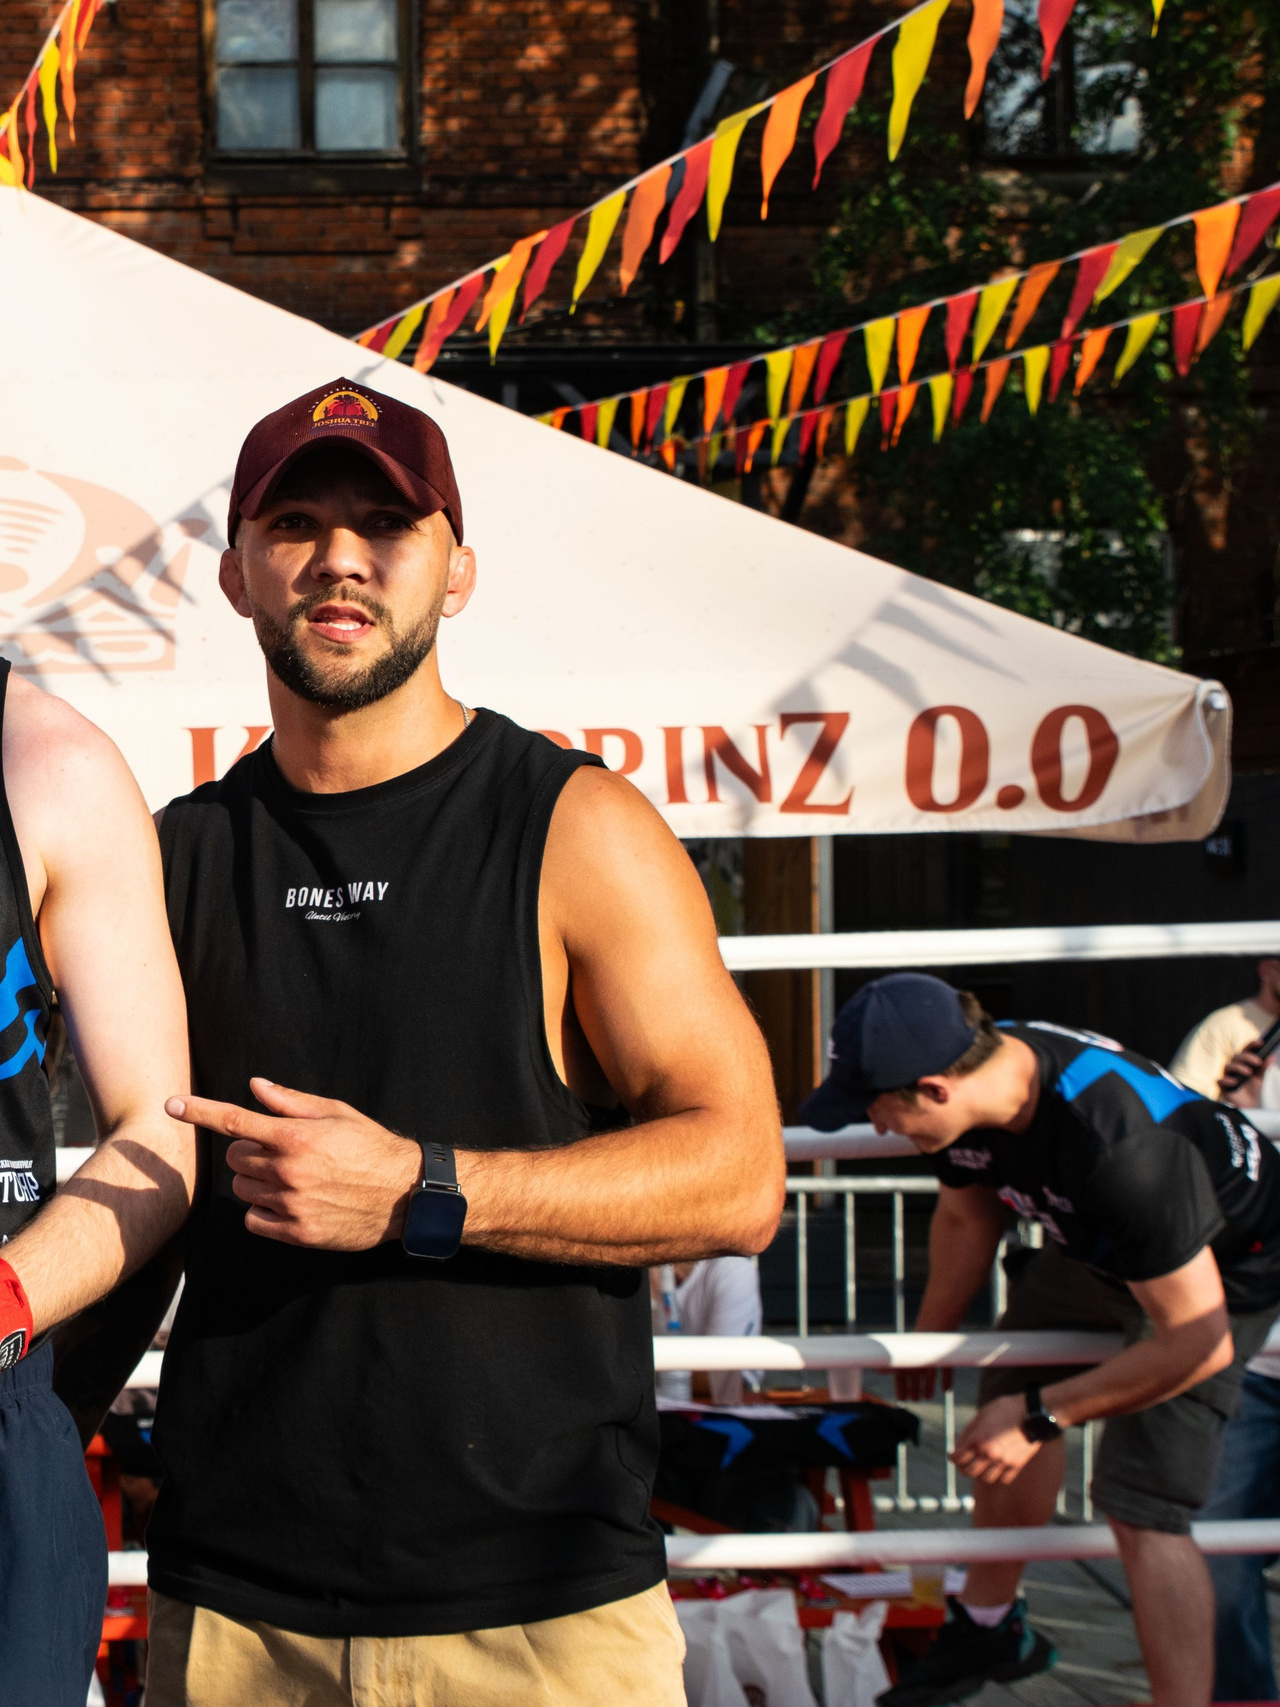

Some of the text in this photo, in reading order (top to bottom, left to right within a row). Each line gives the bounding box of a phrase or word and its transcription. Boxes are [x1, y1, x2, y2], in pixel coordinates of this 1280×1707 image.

[353, 418, 377, 428] TREE
[905, 704, 1118, 813] 0.0
[285, 881, 389, 908] BONES WAY
